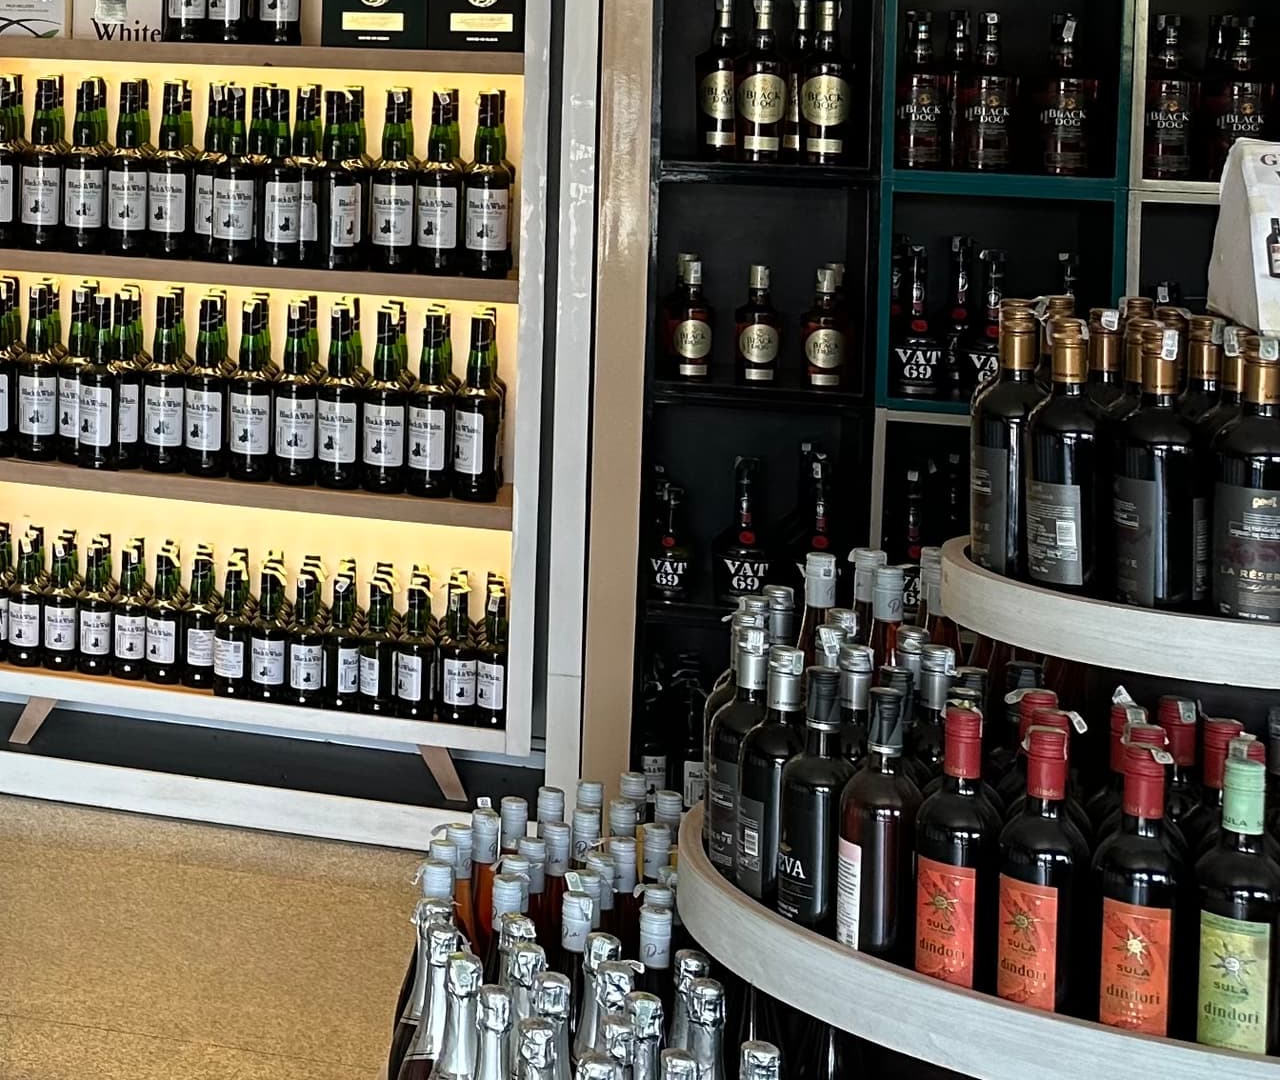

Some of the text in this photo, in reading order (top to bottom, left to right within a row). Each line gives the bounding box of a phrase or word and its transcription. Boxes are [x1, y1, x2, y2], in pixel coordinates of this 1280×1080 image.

[91, 18, 162, 43] White
[746, 90, 781, 100] BLACK
[807, 91, 843, 102] BLACK
[905, 105, 940, 114] BLACK
[973, 107, 1010, 116] BLACK
[1048, 109, 1086, 119] BLACK
[1150, 111, 1189, 121] BLACK
[911, 113, 935, 122] DOG
[980, 115, 1005, 124] DOG
[1055, 118, 1081, 127] DOG
[1226, 114, 1264, 124] BLACK
[1157, 120, 1184, 129] DOG
[1232, 123, 1260, 132] DOG
[895, 348, 941, 365] VAT
[903, 365, 932, 380] 69
[650, 558, 687, 574] VAT
[724, 559, 768, 576] VAT
[656, 573, 679, 586] 69
[1240, 568, 1280, 581] RÉSER
[732, 576, 759, 590] 69
[927, 918, 956, 932] SULA
[919, 937, 965, 960] dindori
[1007, 938, 1037, 952] SULA
[1001, 957, 1047, 981] dindori
[1116, 963, 1150, 977] SULA
[1106, 984, 1161, 1006] dindori
[1213, 981, 1249, 997] SULA
[1203, 1002, 1259, 1026] dindori
